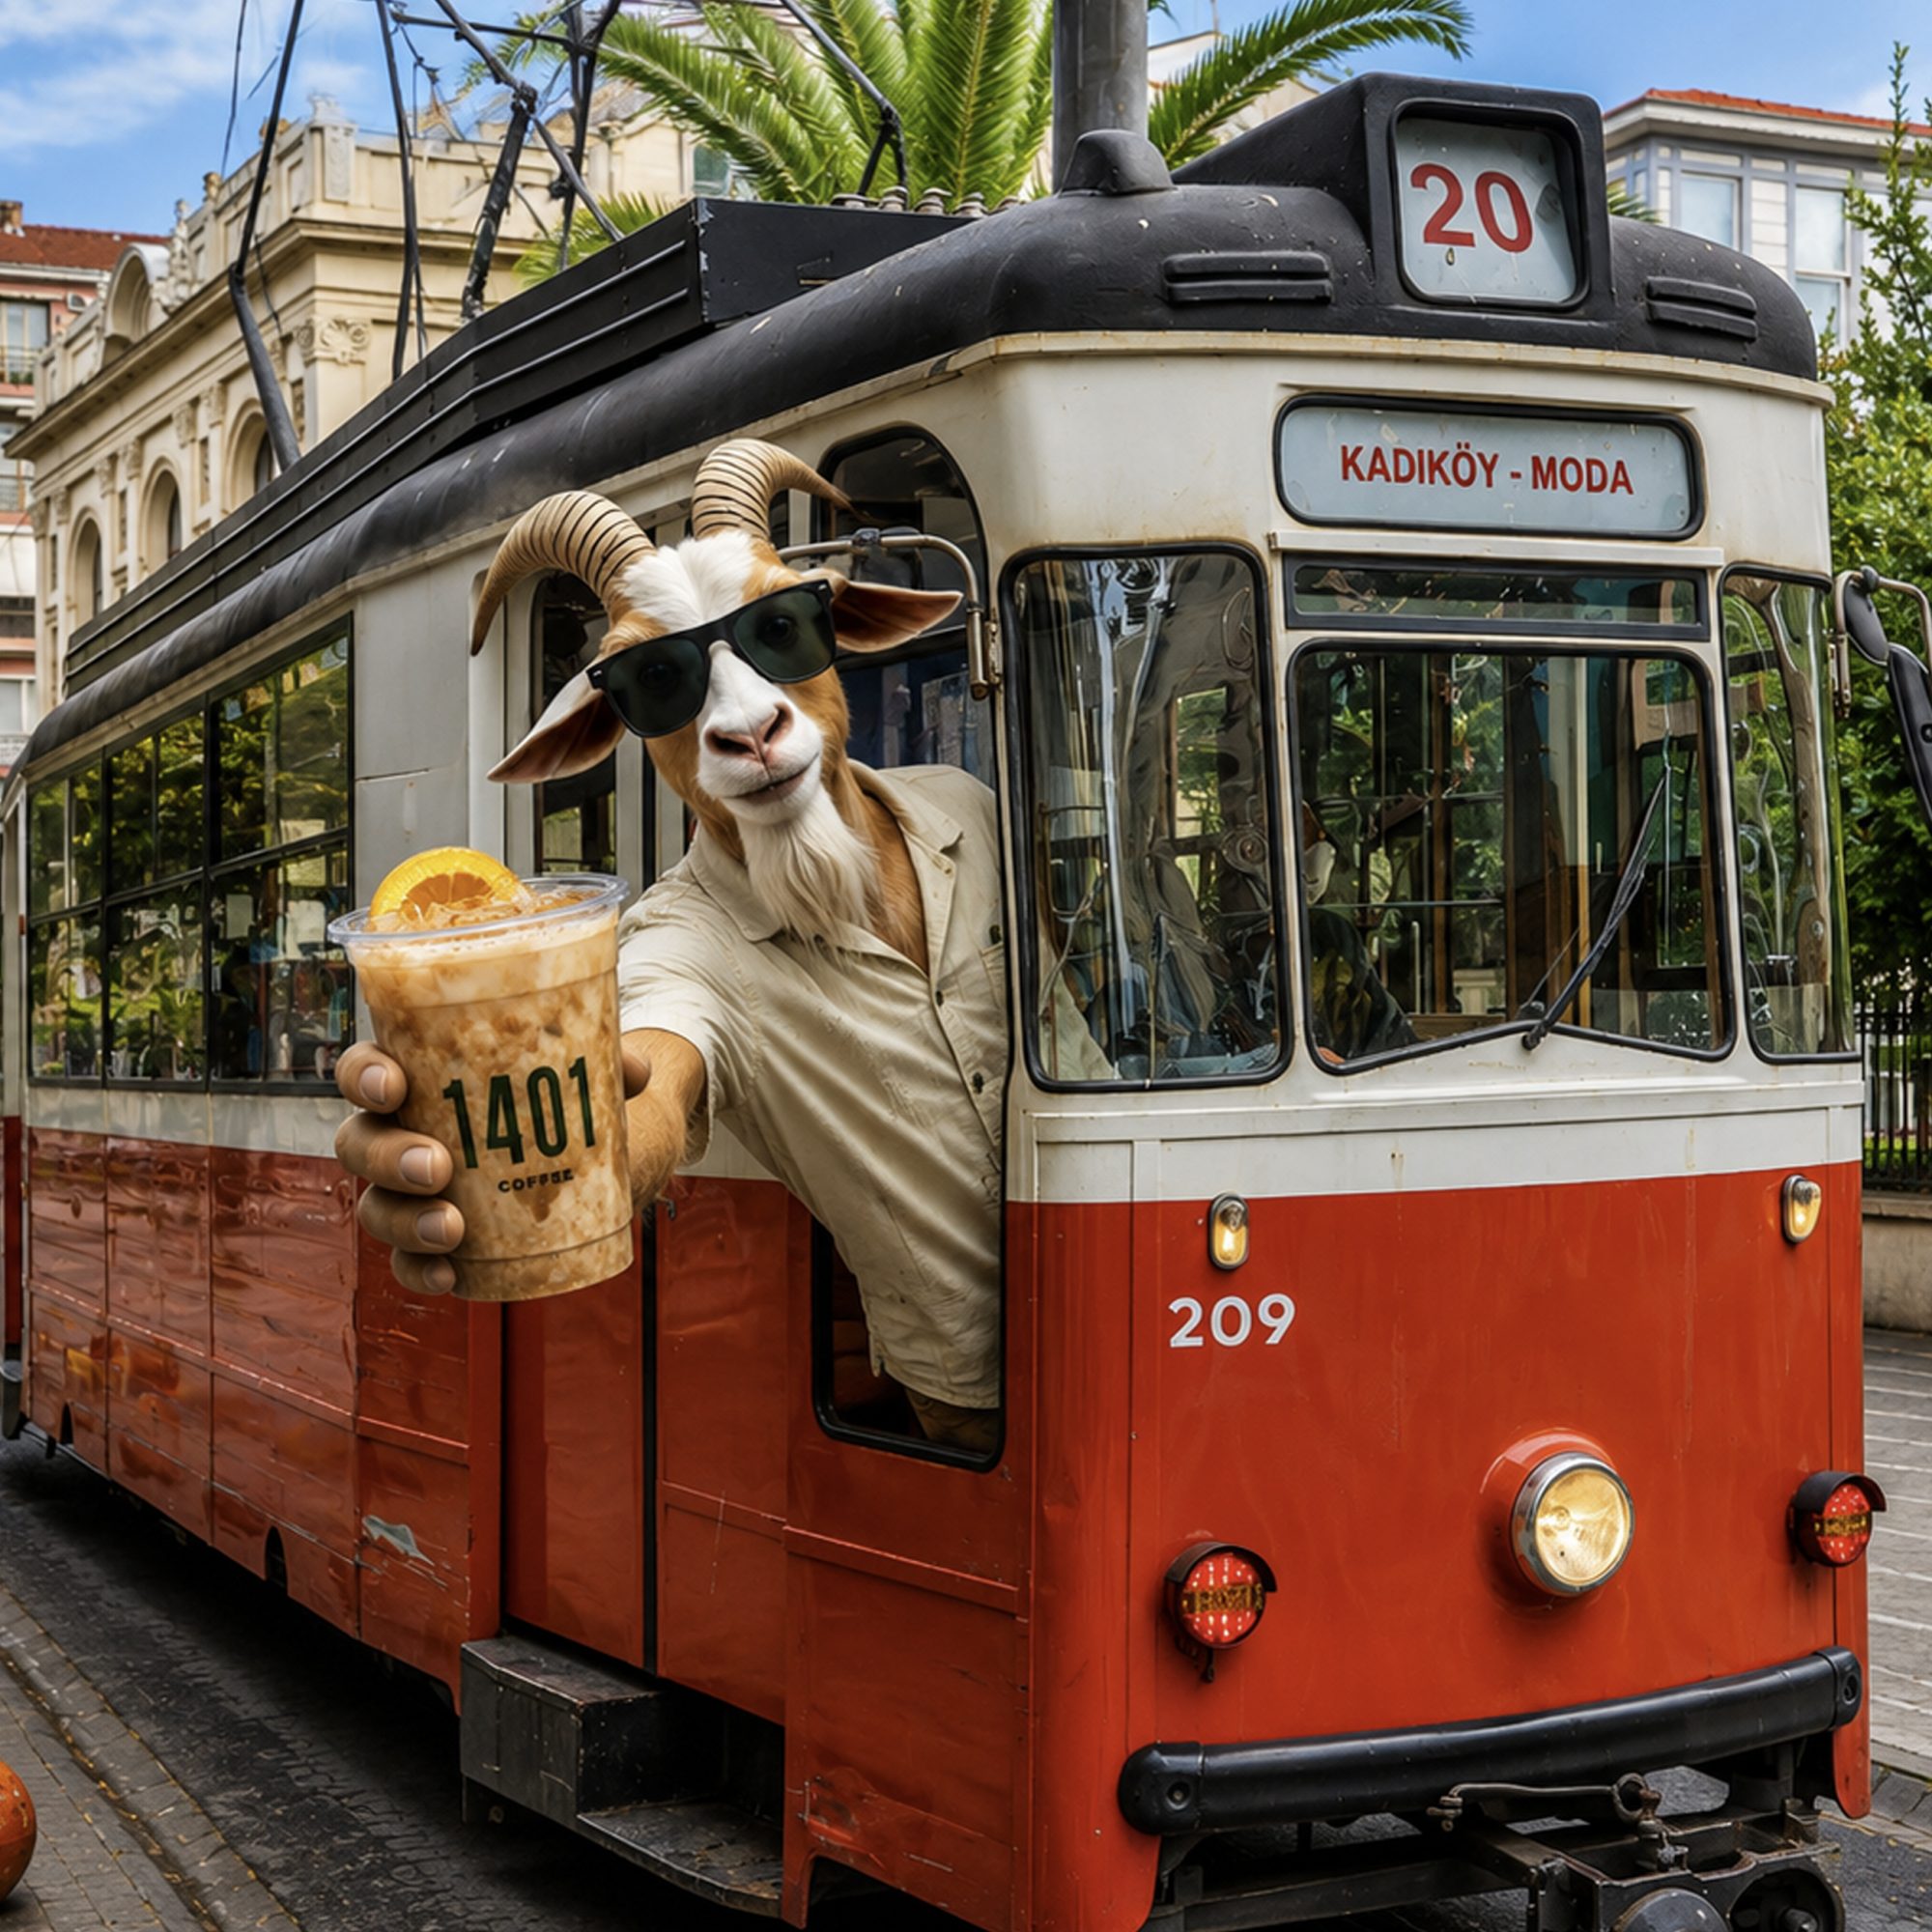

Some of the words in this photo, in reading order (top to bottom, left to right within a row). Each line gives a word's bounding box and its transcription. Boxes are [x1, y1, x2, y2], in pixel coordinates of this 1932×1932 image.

[1410, 163, 1533, 253] 20
[1341, 441, 1499, 488] KADIKÖY
[1531, 455, 1634, 496] MODA
[442, 1056, 596, 1169] 1401
[1169, 1293, 1295, 1348] 209
